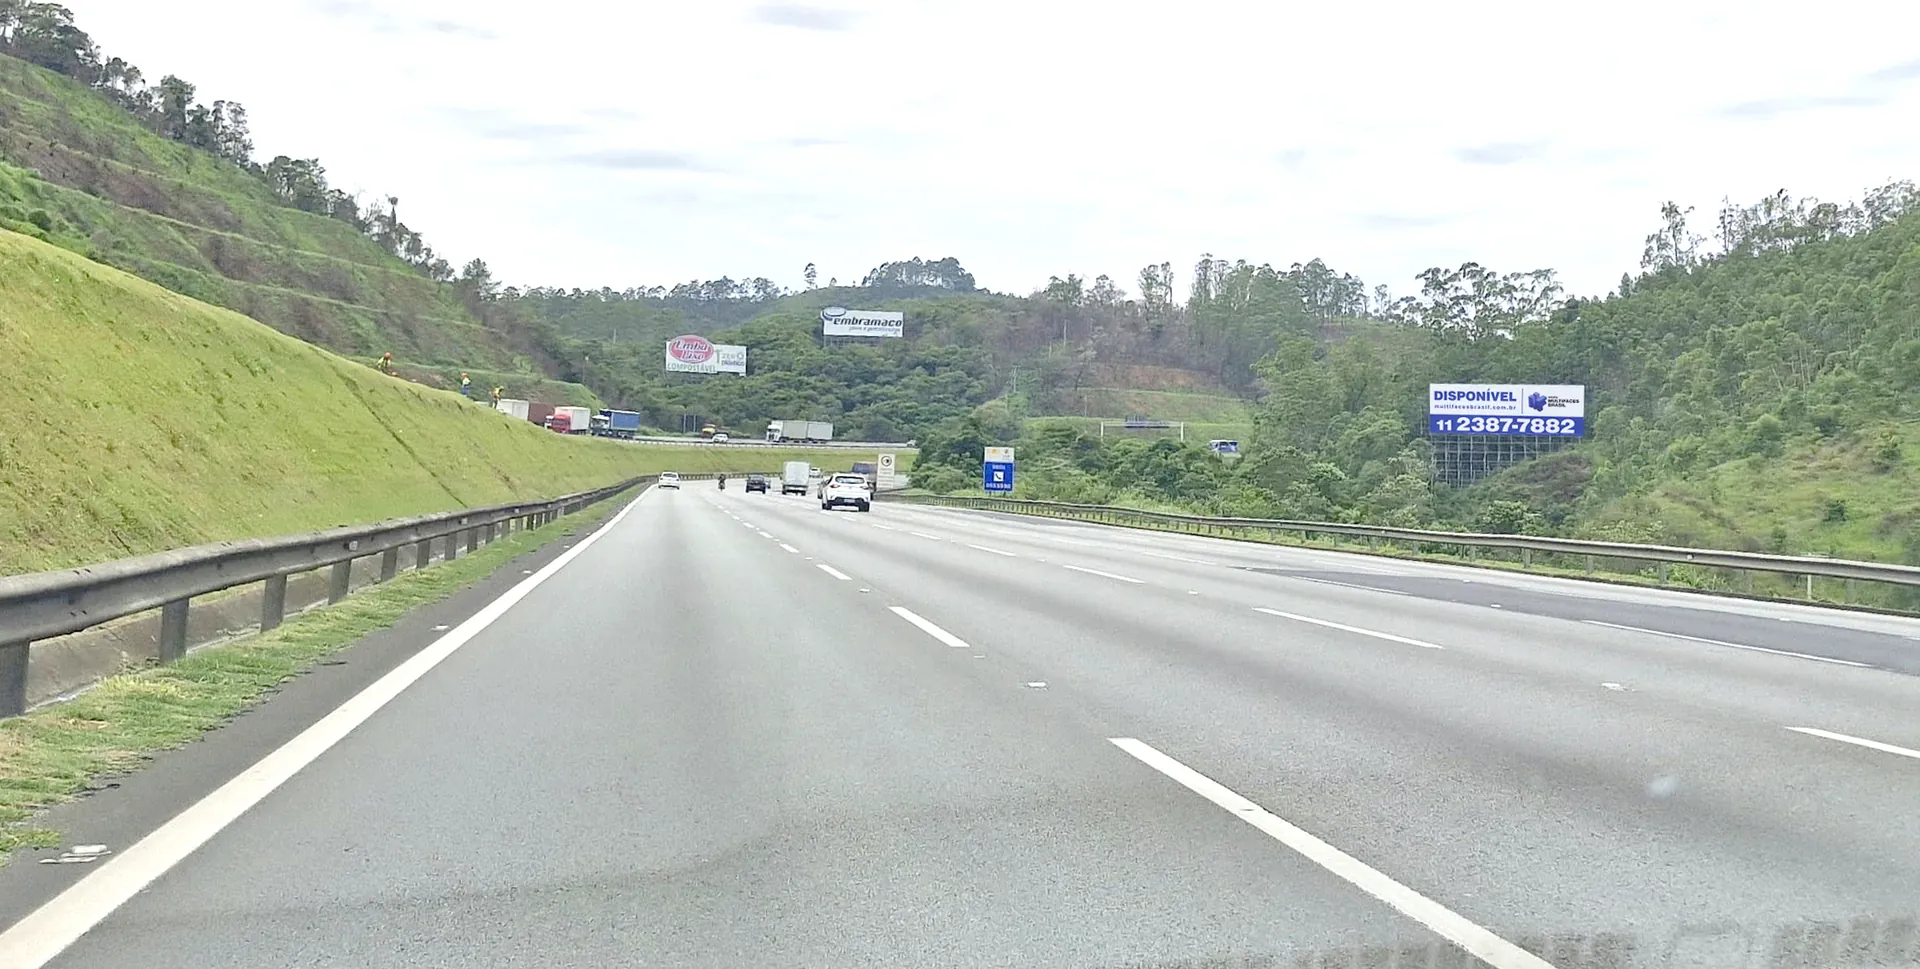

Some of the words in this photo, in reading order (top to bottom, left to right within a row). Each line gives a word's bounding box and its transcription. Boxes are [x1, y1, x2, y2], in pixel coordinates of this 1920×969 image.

[833, 316, 902, 327] embramaco
[1434, 388, 1517, 402] DISPONÍVEL
[1436, 419, 1453, 431] 11
[1456, 417, 1576, 434] 2387-7882
